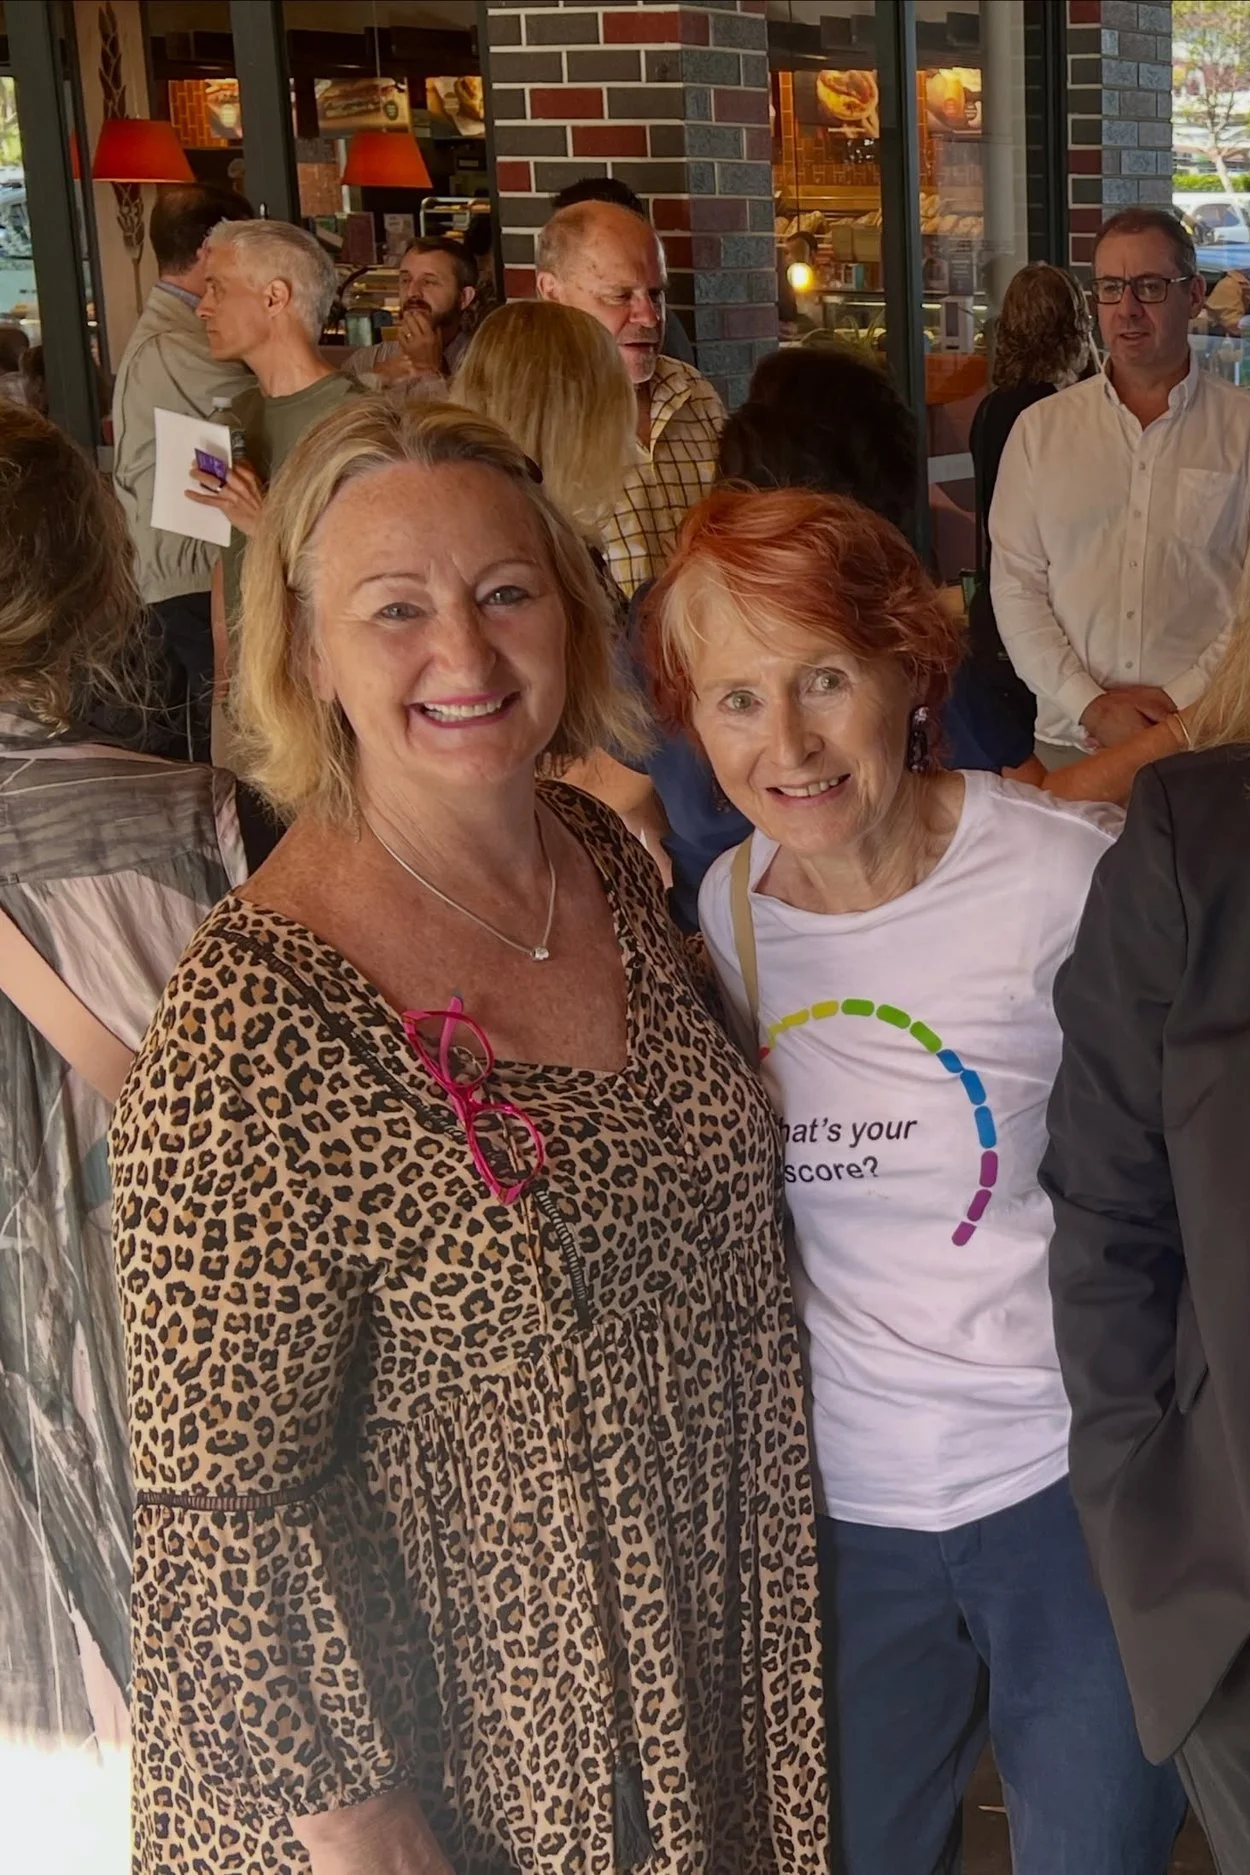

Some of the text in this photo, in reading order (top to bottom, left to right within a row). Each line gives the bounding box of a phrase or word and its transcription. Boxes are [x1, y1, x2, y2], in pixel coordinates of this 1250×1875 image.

[780, 1117, 919, 1149] hat's your
[784, 1155, 880, 1184] score?
